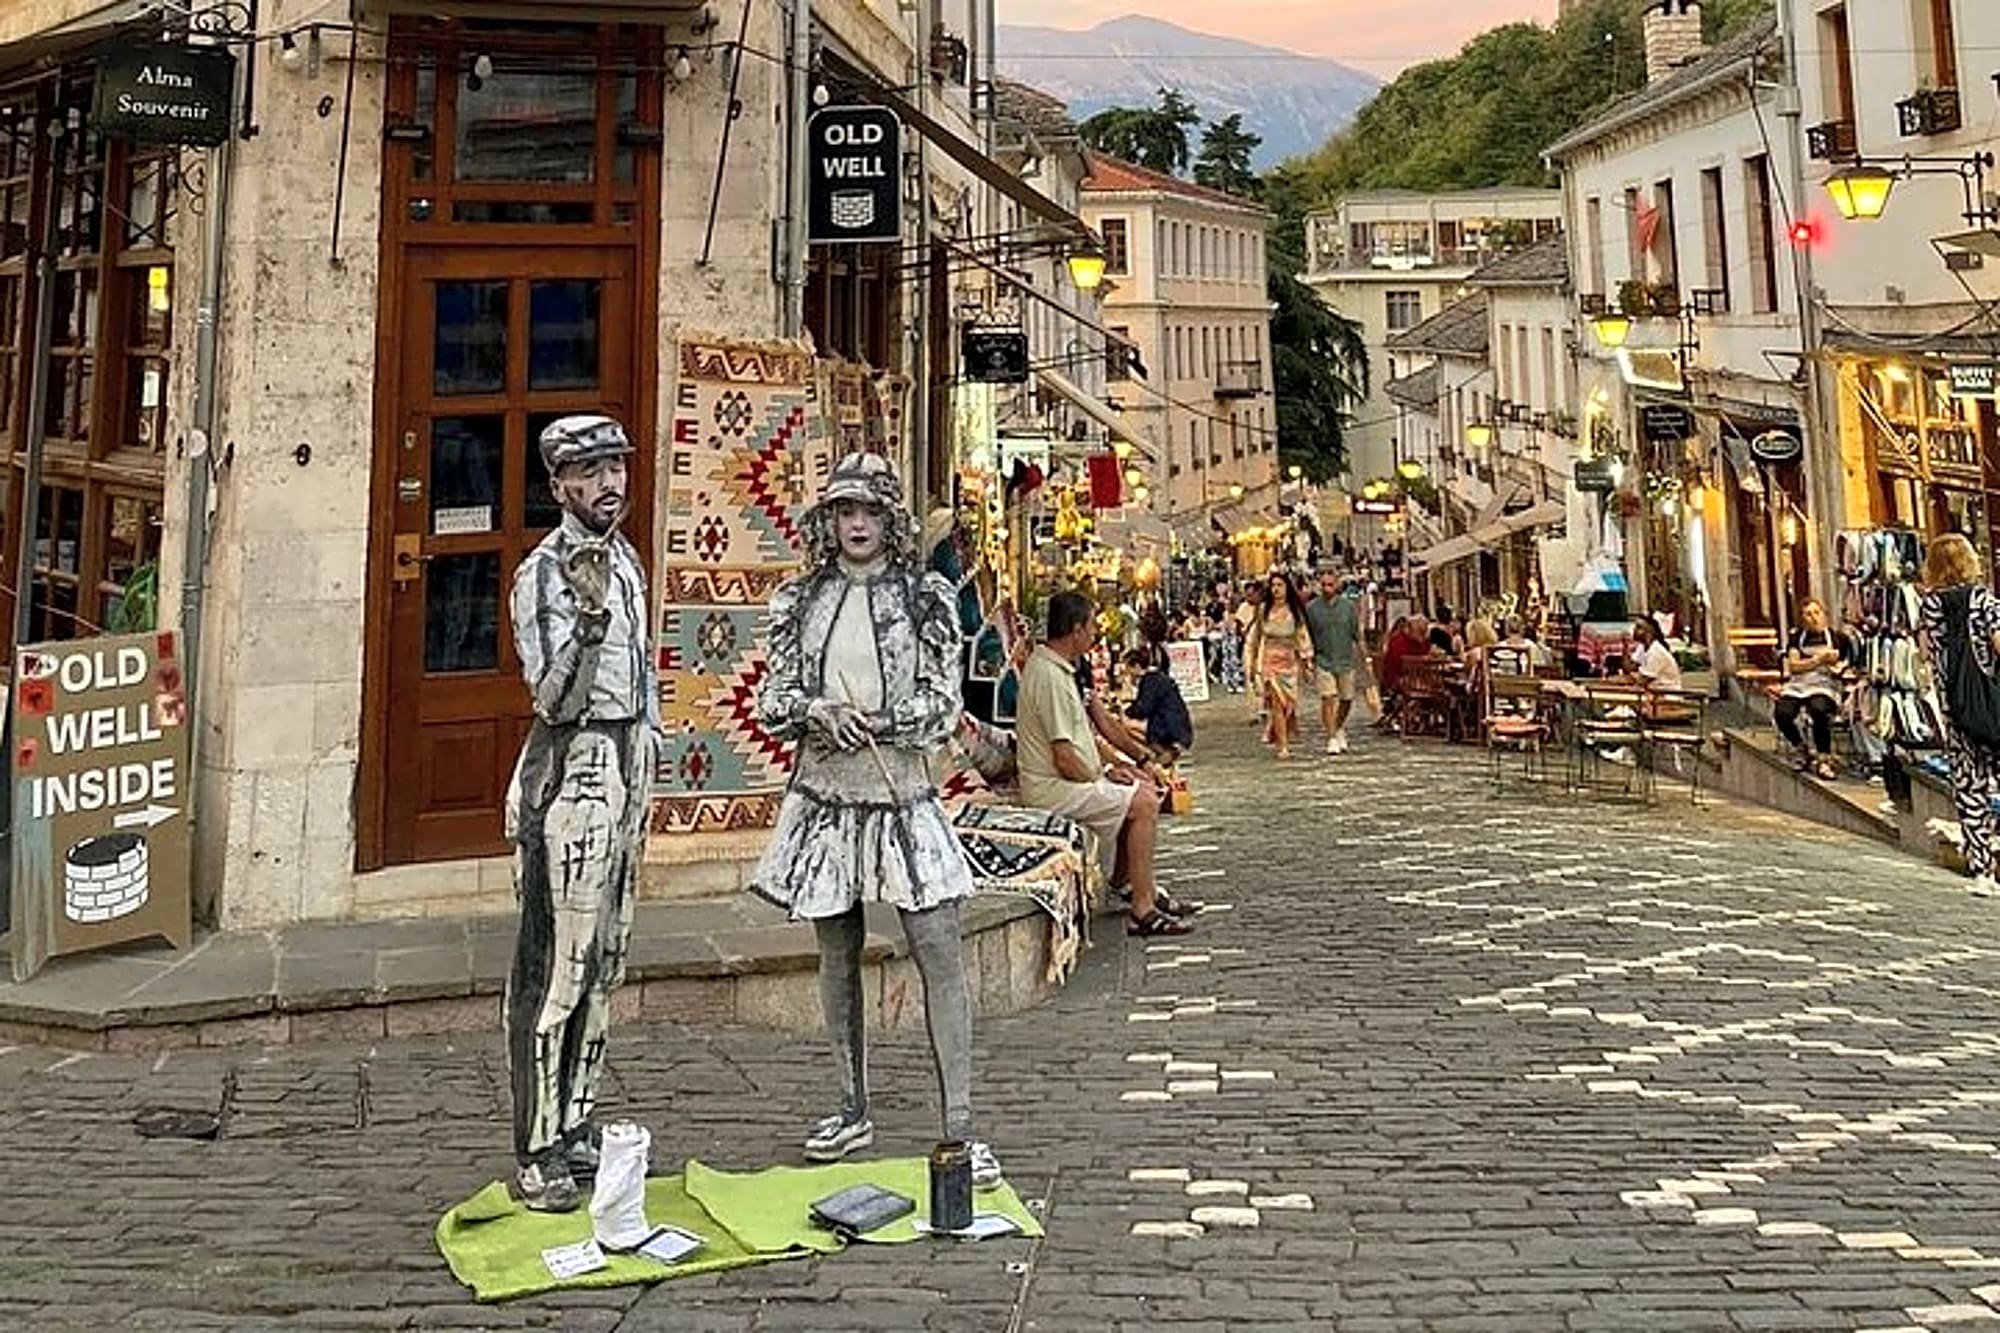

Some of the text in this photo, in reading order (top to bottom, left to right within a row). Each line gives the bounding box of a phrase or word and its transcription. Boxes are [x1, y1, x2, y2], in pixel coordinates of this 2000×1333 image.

[137, 65, 193, 88] Alma
[118, 93, 209, 120] Souvenir
[824, 123, 884, 146] OLD
[822, 155, 887, 178] WELL
[60, 648, 148, 693] OLD
[46, 703, 162, 755] WELL
[32, 757, 176, 819] INSIDE
